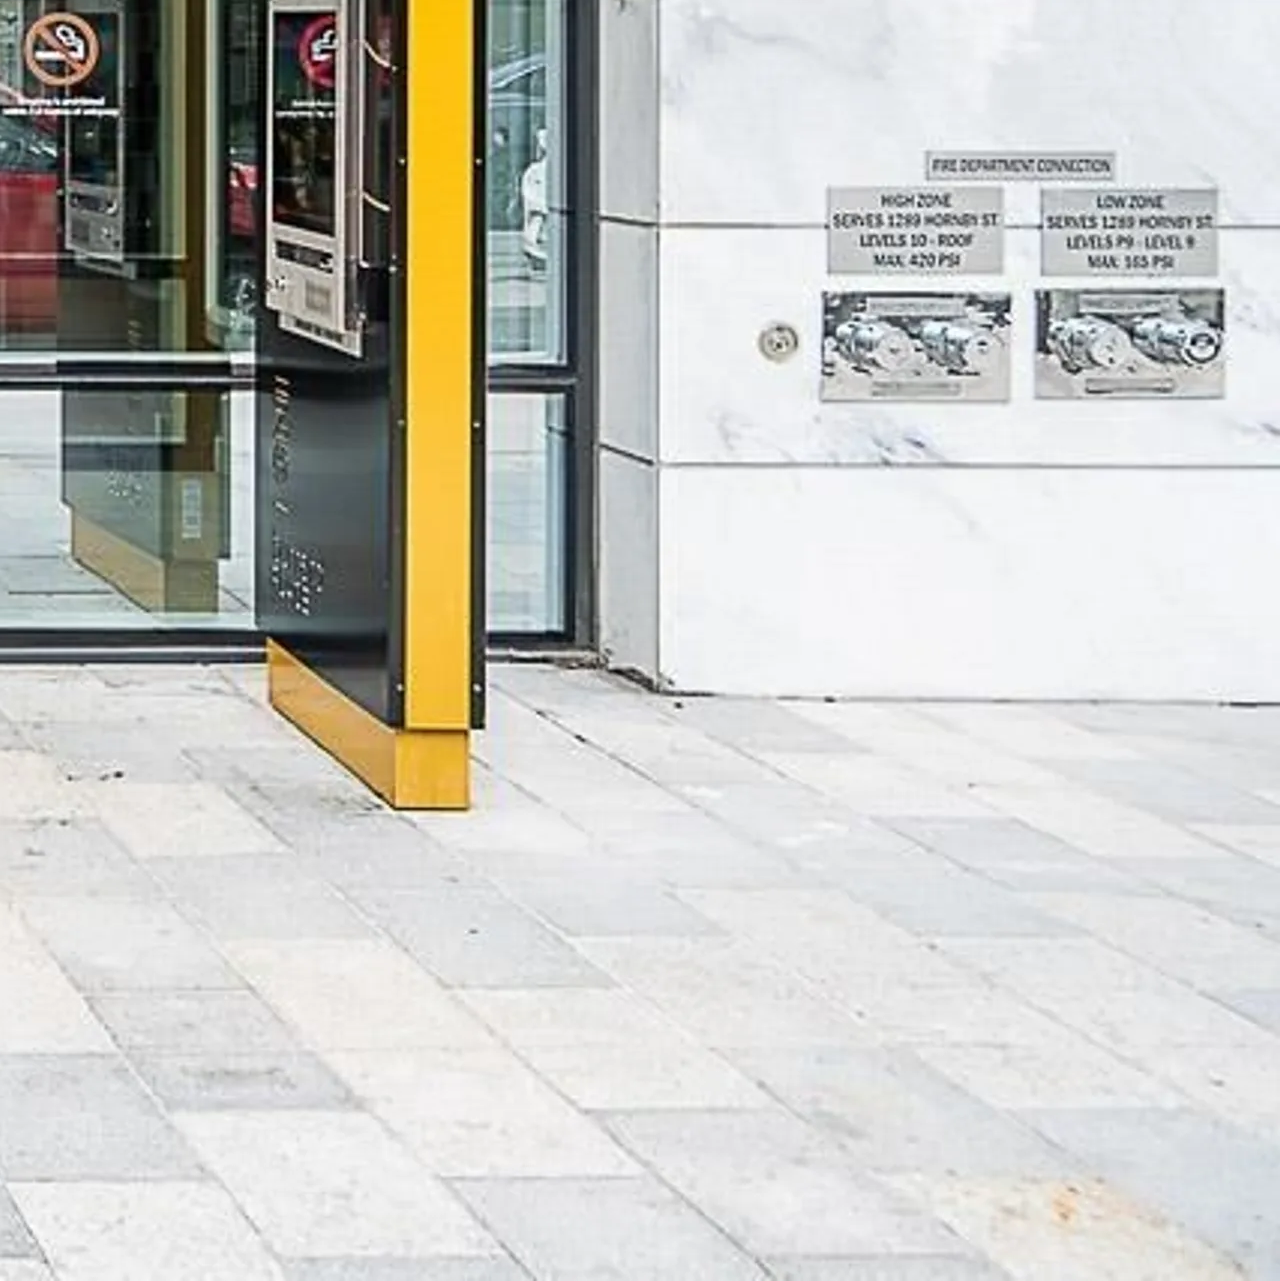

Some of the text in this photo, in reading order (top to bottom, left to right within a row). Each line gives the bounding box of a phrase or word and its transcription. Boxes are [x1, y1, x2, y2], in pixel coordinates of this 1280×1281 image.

[931, 158, 1111, 173] FIRE DEPARTMENT CONNECTION
[880, 193, 952, 208] HIGH ZONE
[1096, 194, 1165, 209] LOW ZONE
[832, 213, 884, 228] SERVES
[924, 212, 978, 227] HORNBY
[1046, 215, 1099, 229] SERVES
[1138, 214, 1192, 229] HORNBY
[859, 233, 907, 248] LEVELS
[910, 233, 928, 247] 10
[937, 233, 973, 247] ROOF
[1066, 235, 1114, 250] LEVELS
[1144, 235, 1183, 250] LEVEL
[909, 253, 936, 268] 420
[938, 253, 961, 268] PSI
[1152, 255, 1174, 269] PSI
